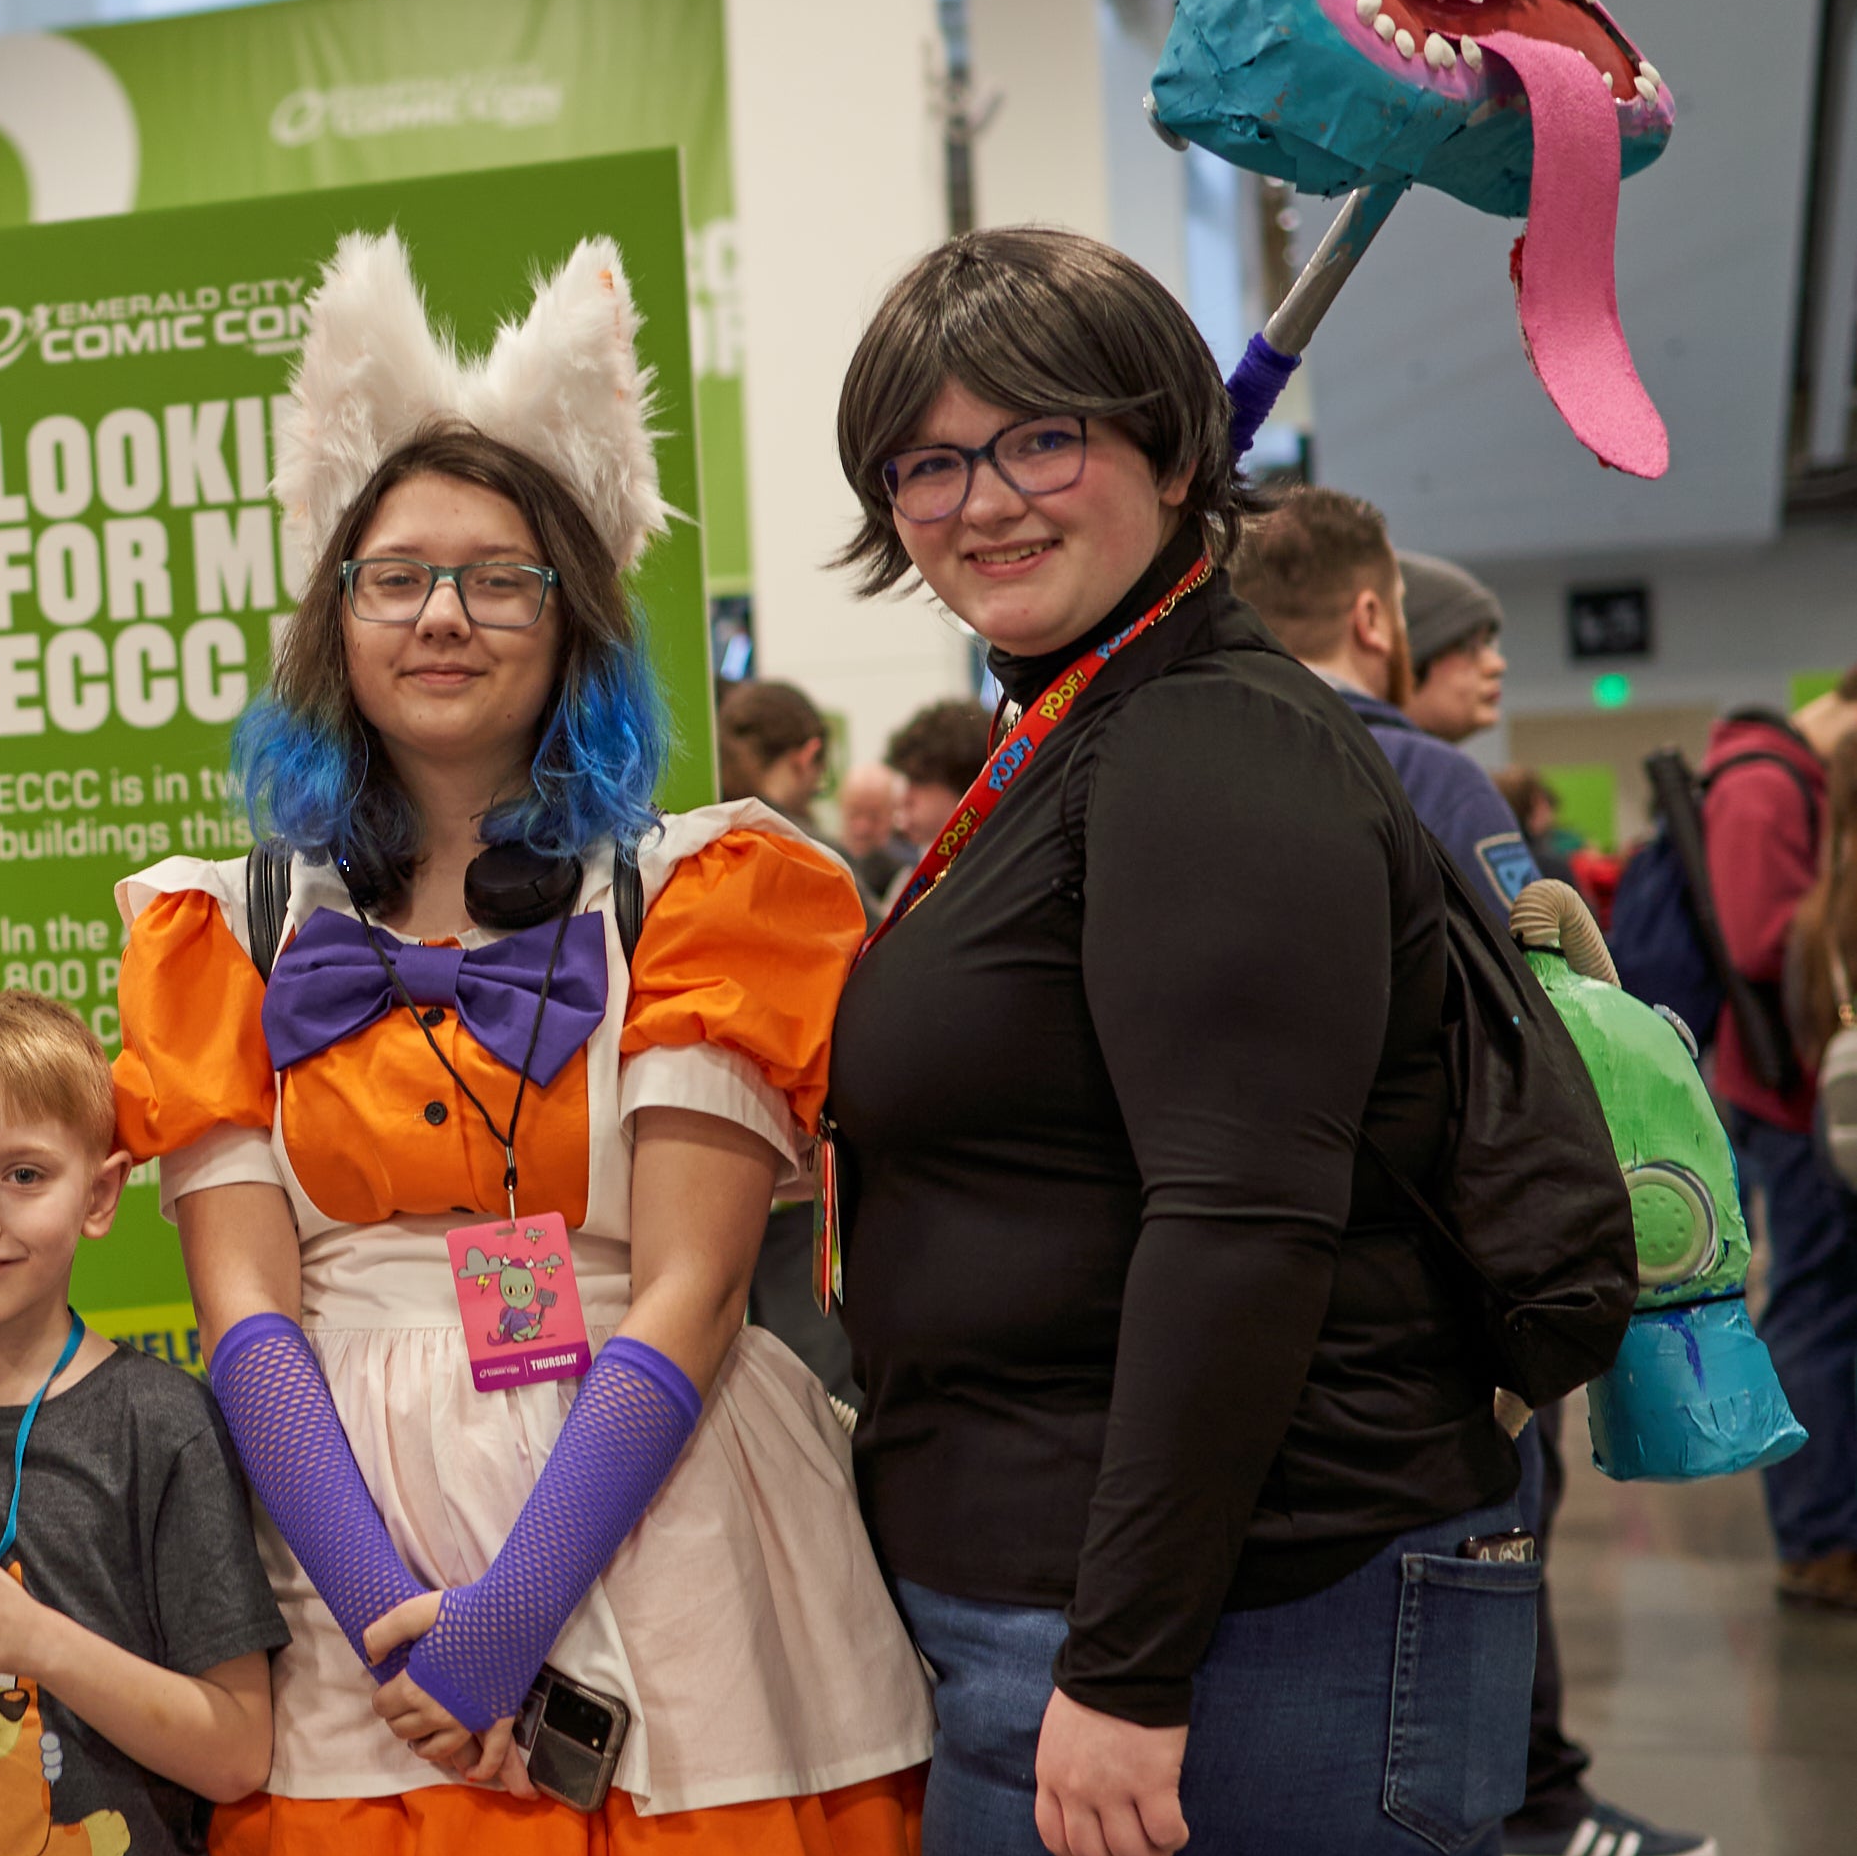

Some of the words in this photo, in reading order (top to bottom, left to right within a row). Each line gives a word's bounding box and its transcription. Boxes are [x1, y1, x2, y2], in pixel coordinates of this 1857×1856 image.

[56, 286, 221, 326] EMERALD
[227, 277, 305, 307] CITY
[41, 314, 206, 364] COMIC
[1040, 668, 1087, 722] POOF!
[110, 766, 144, 807] is
[153, 764, 189, 803] in
[988, 735, 1034, 793] POOF!
[180, 809, 254, 851] this
[936, 806, 980, 858] POOF!
[0, 915, 36, 955] In
[46, 913, 109, 953] the
[3, 959, 87, 1000] 800
[530, 1352, 577, 1371] THURSDAY
